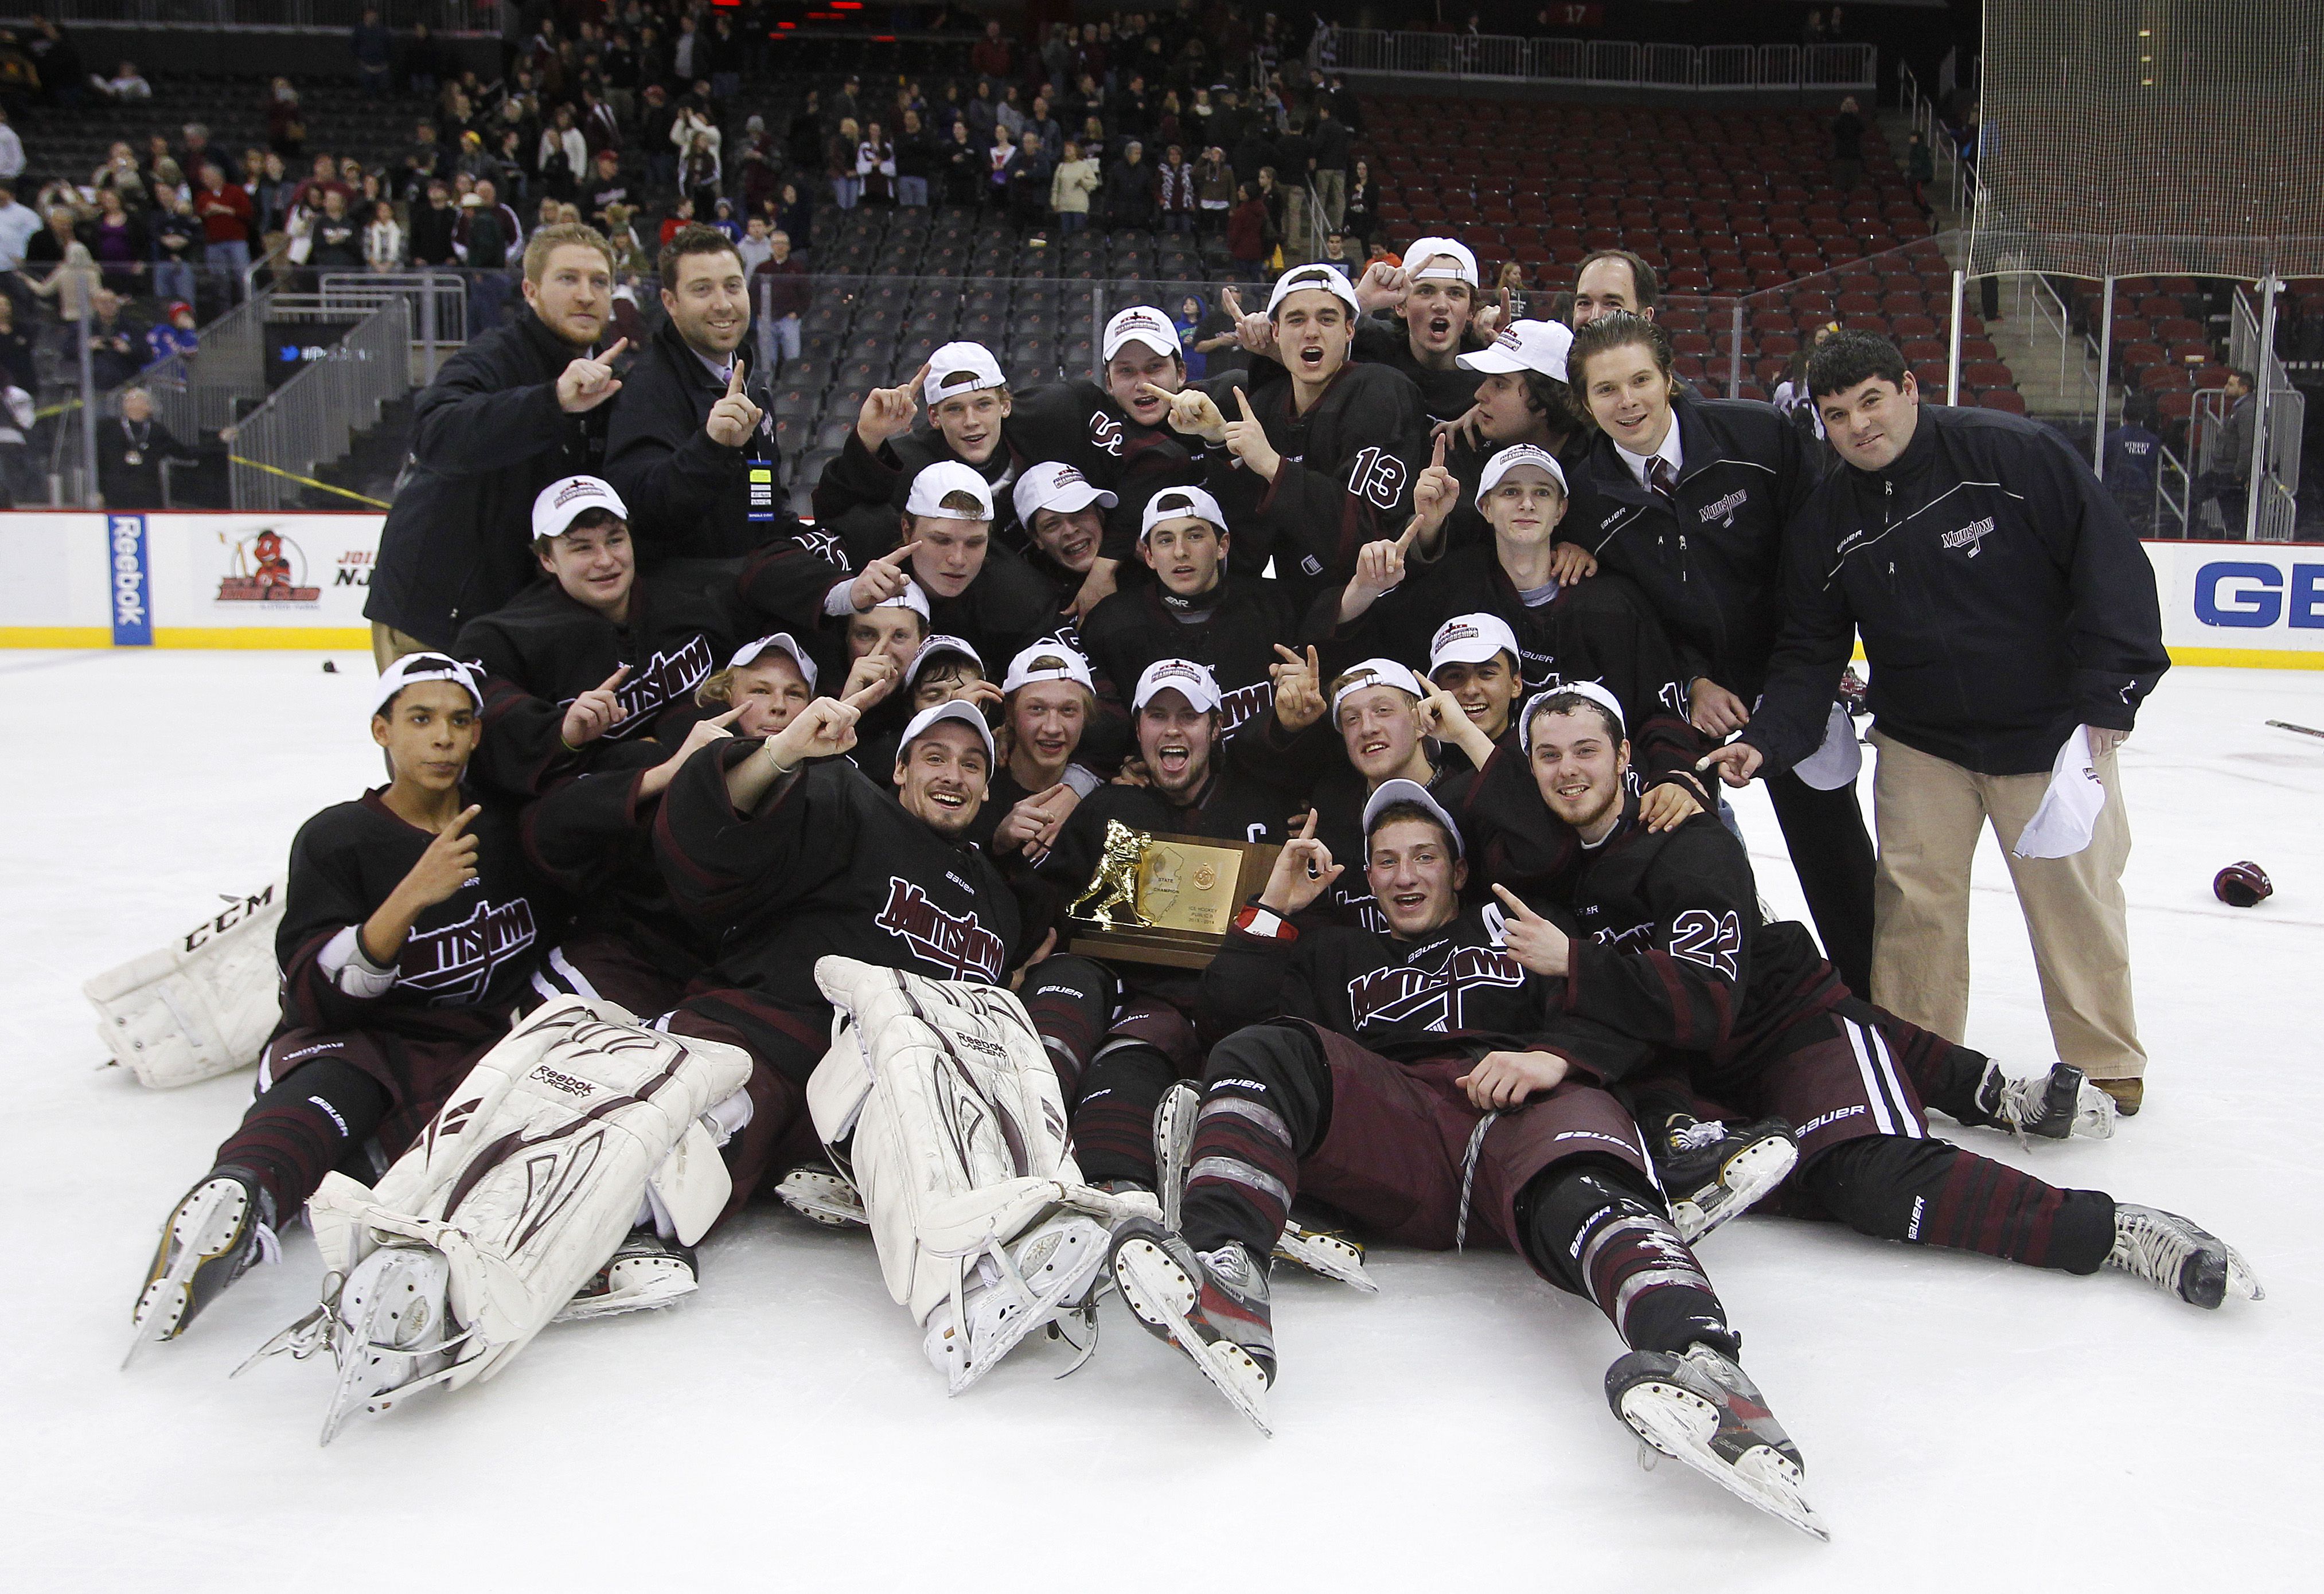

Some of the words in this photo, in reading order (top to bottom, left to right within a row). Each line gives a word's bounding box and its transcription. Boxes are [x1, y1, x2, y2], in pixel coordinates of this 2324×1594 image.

[1565, 5, 1586, 22] 17
[2124, 441, 2150, 449] STREET
[1348, 447, 1407, 509] 13
[112, 516, 145, 626] Reebok
[1520, 650, 1554, 663] AUER
[945, 870, 975, 895] BAUER
[185, 885, 274, 952] CCM
[1036, 985, 1083, 999] BAUER
[957, 1032, 1007, 1054] Reebok
[961, 1041, 1009, 1060] LARCENY
[529, 1072, 591, 1099] LARCENY
[536, 1065, 596, 1094] Reebok
[1210, 1079, 1266, 1092] BAUER
[1908, 1195, 1925, 1240] BAUER
[1569, 1205, 1611, 1259] BAUER
